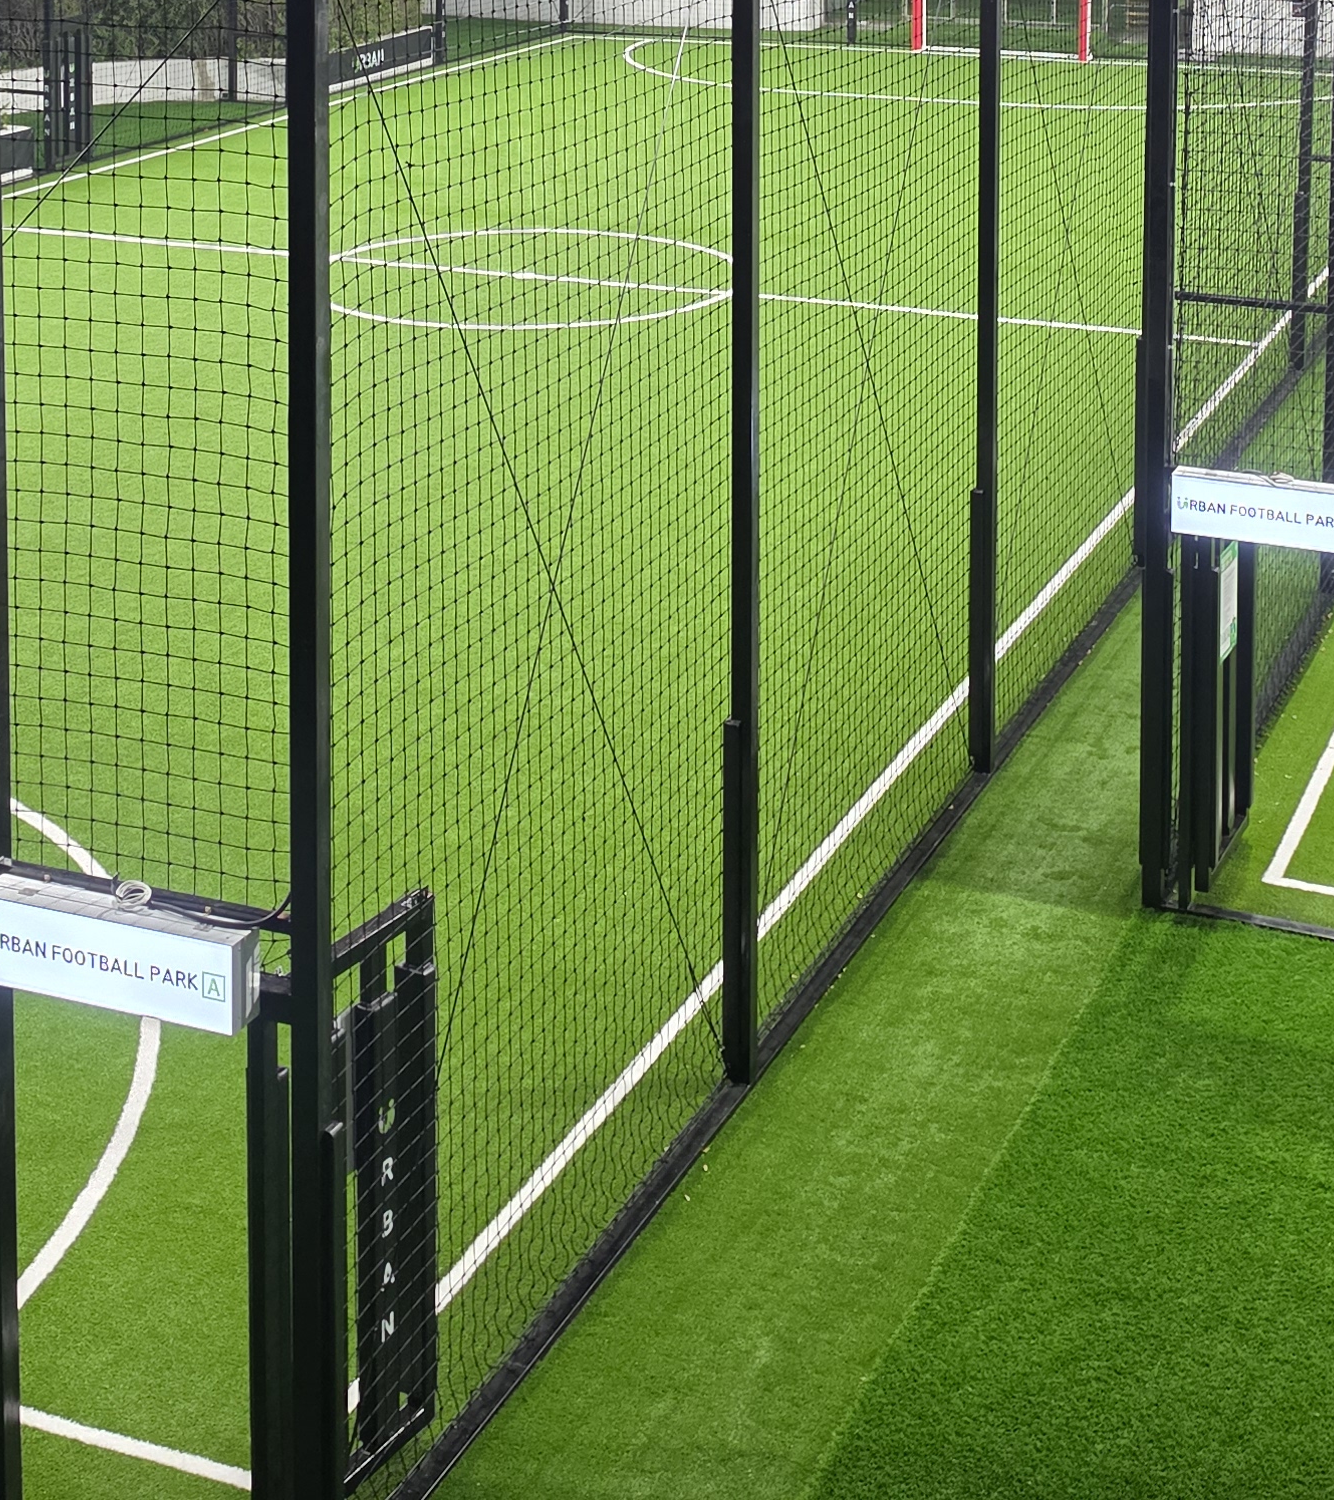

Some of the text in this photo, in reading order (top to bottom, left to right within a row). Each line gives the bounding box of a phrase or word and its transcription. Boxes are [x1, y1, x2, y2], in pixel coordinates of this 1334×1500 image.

[1230, 504, 1302, 525] FOOTBALL
[52, 944, 145, 980] FOOTBALL
[150, 965, 199, 991] PARK
[207, 977, 221, 997] A
